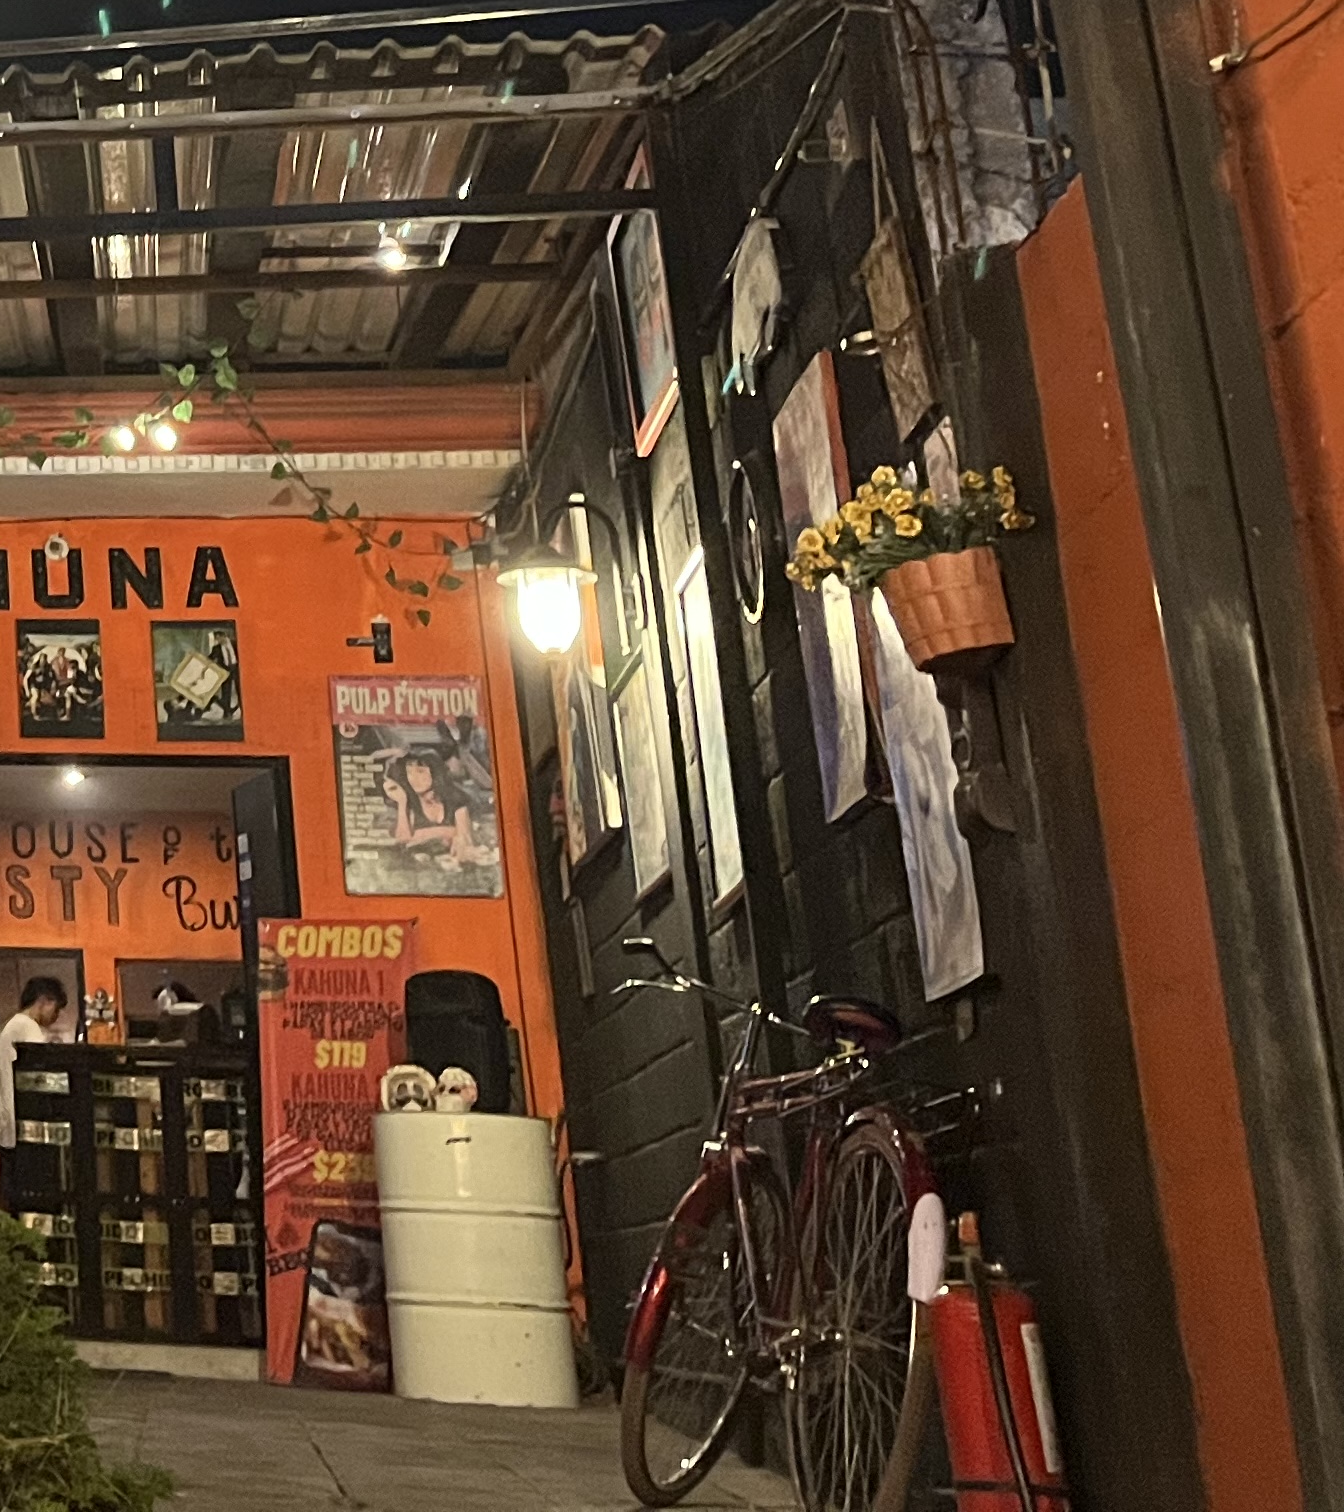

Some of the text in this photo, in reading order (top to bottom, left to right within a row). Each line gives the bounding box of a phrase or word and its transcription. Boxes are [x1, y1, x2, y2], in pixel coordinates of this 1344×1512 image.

[336, 681, 479, 716] PULP FICTION
[277, 925, 404, 959] COMBOS
[293, 969, 371, 996] KAHUNA
[314, 1038, 367, 1070] $119
[290, 1073, 370, 1102] KAHUNA
